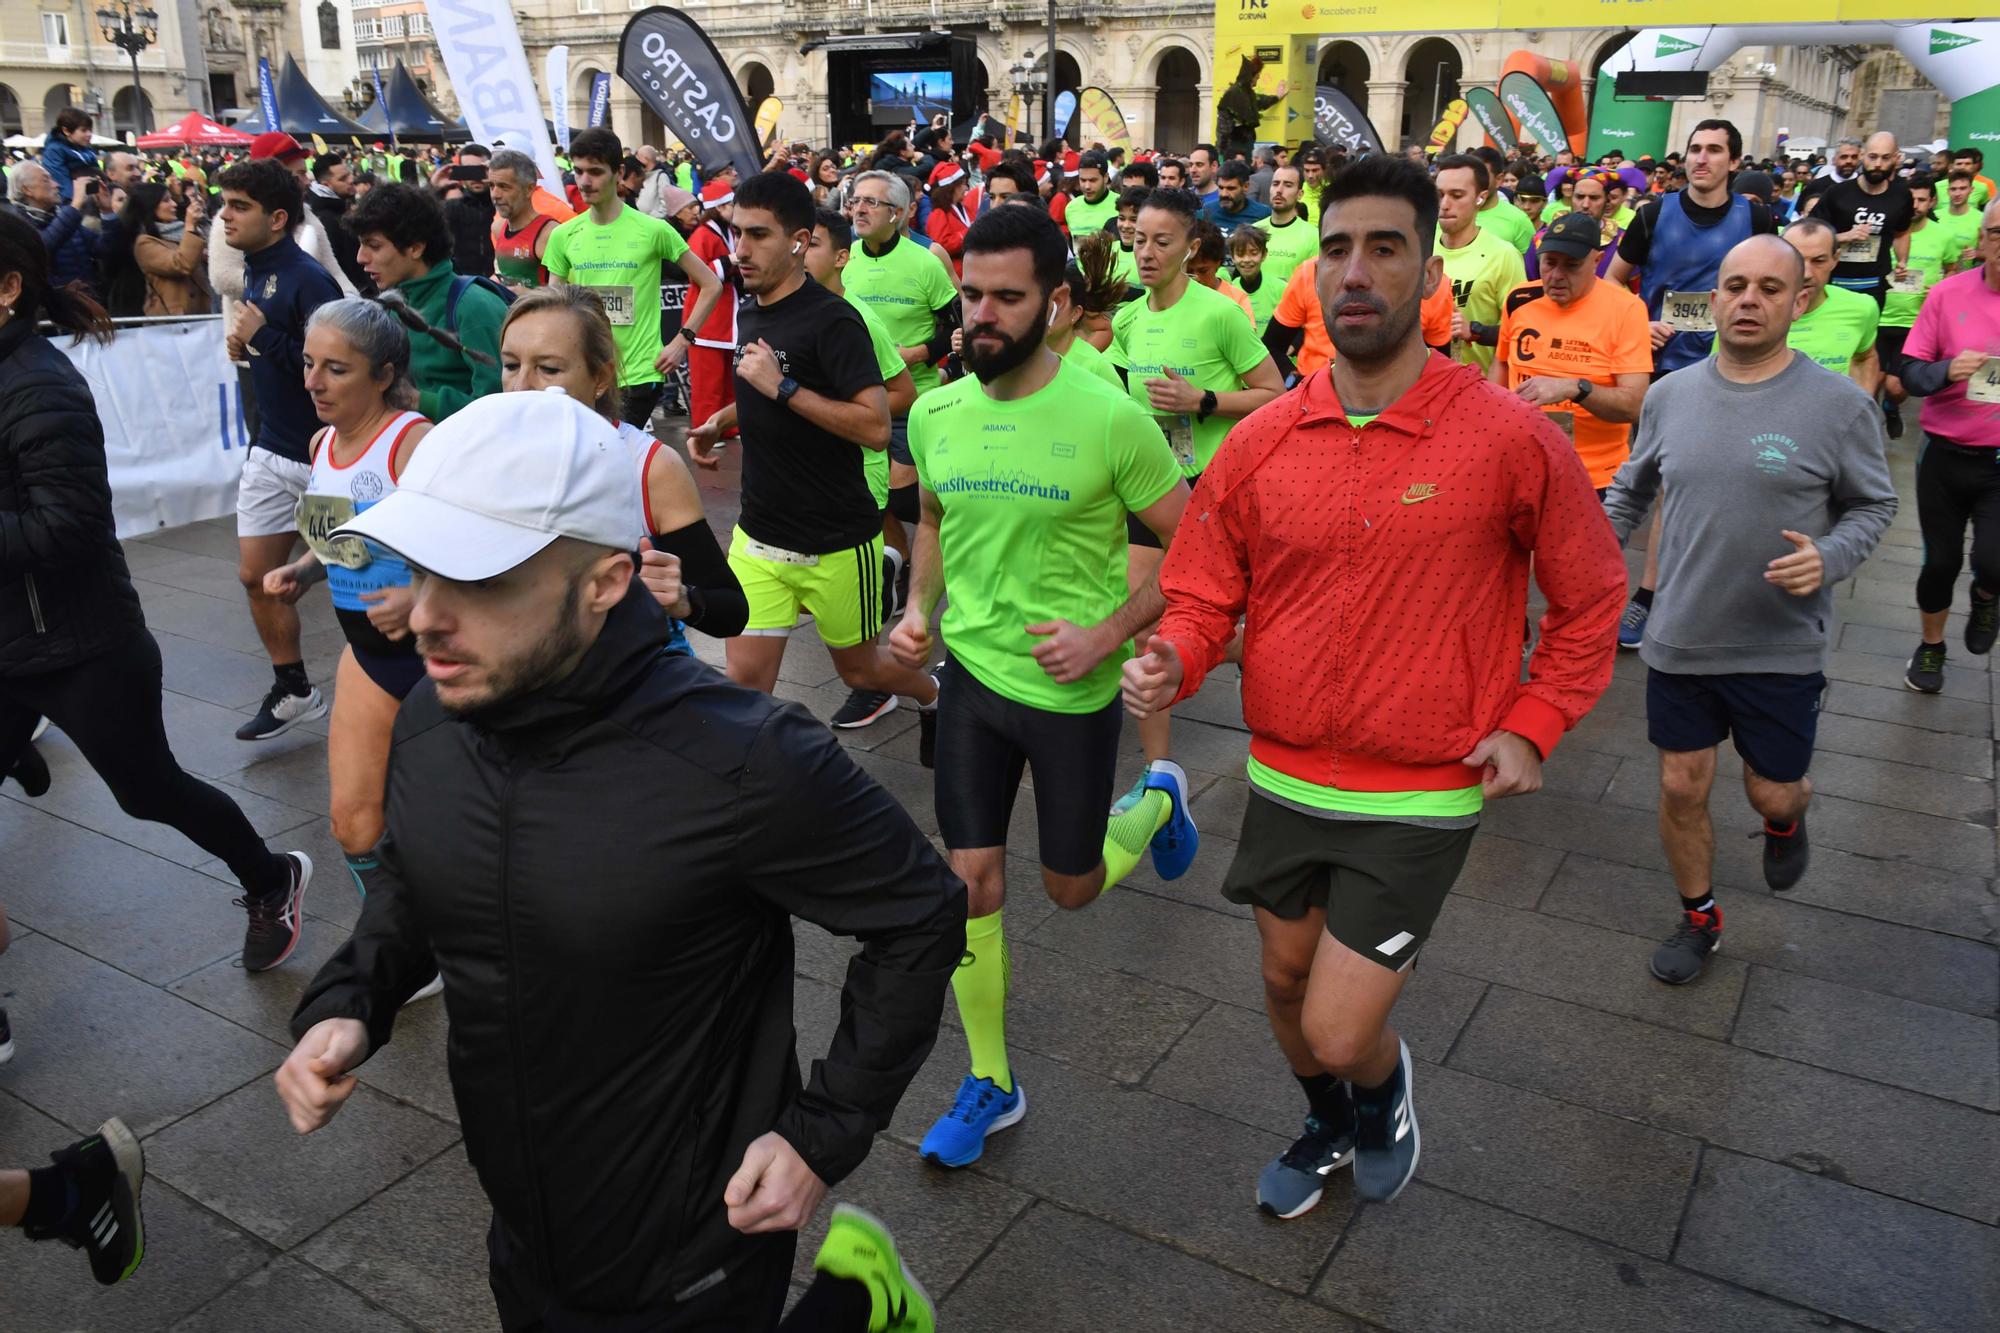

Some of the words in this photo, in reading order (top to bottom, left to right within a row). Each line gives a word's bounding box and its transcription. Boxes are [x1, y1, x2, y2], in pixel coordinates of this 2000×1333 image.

[1672, 303, 1708, 318] 3947
[983, 424, 1016, 432] ABANCA
[933, 477, 1070, 501] SanSilvestreCoruña
[1408, 483, 1437, 497] NIKE
